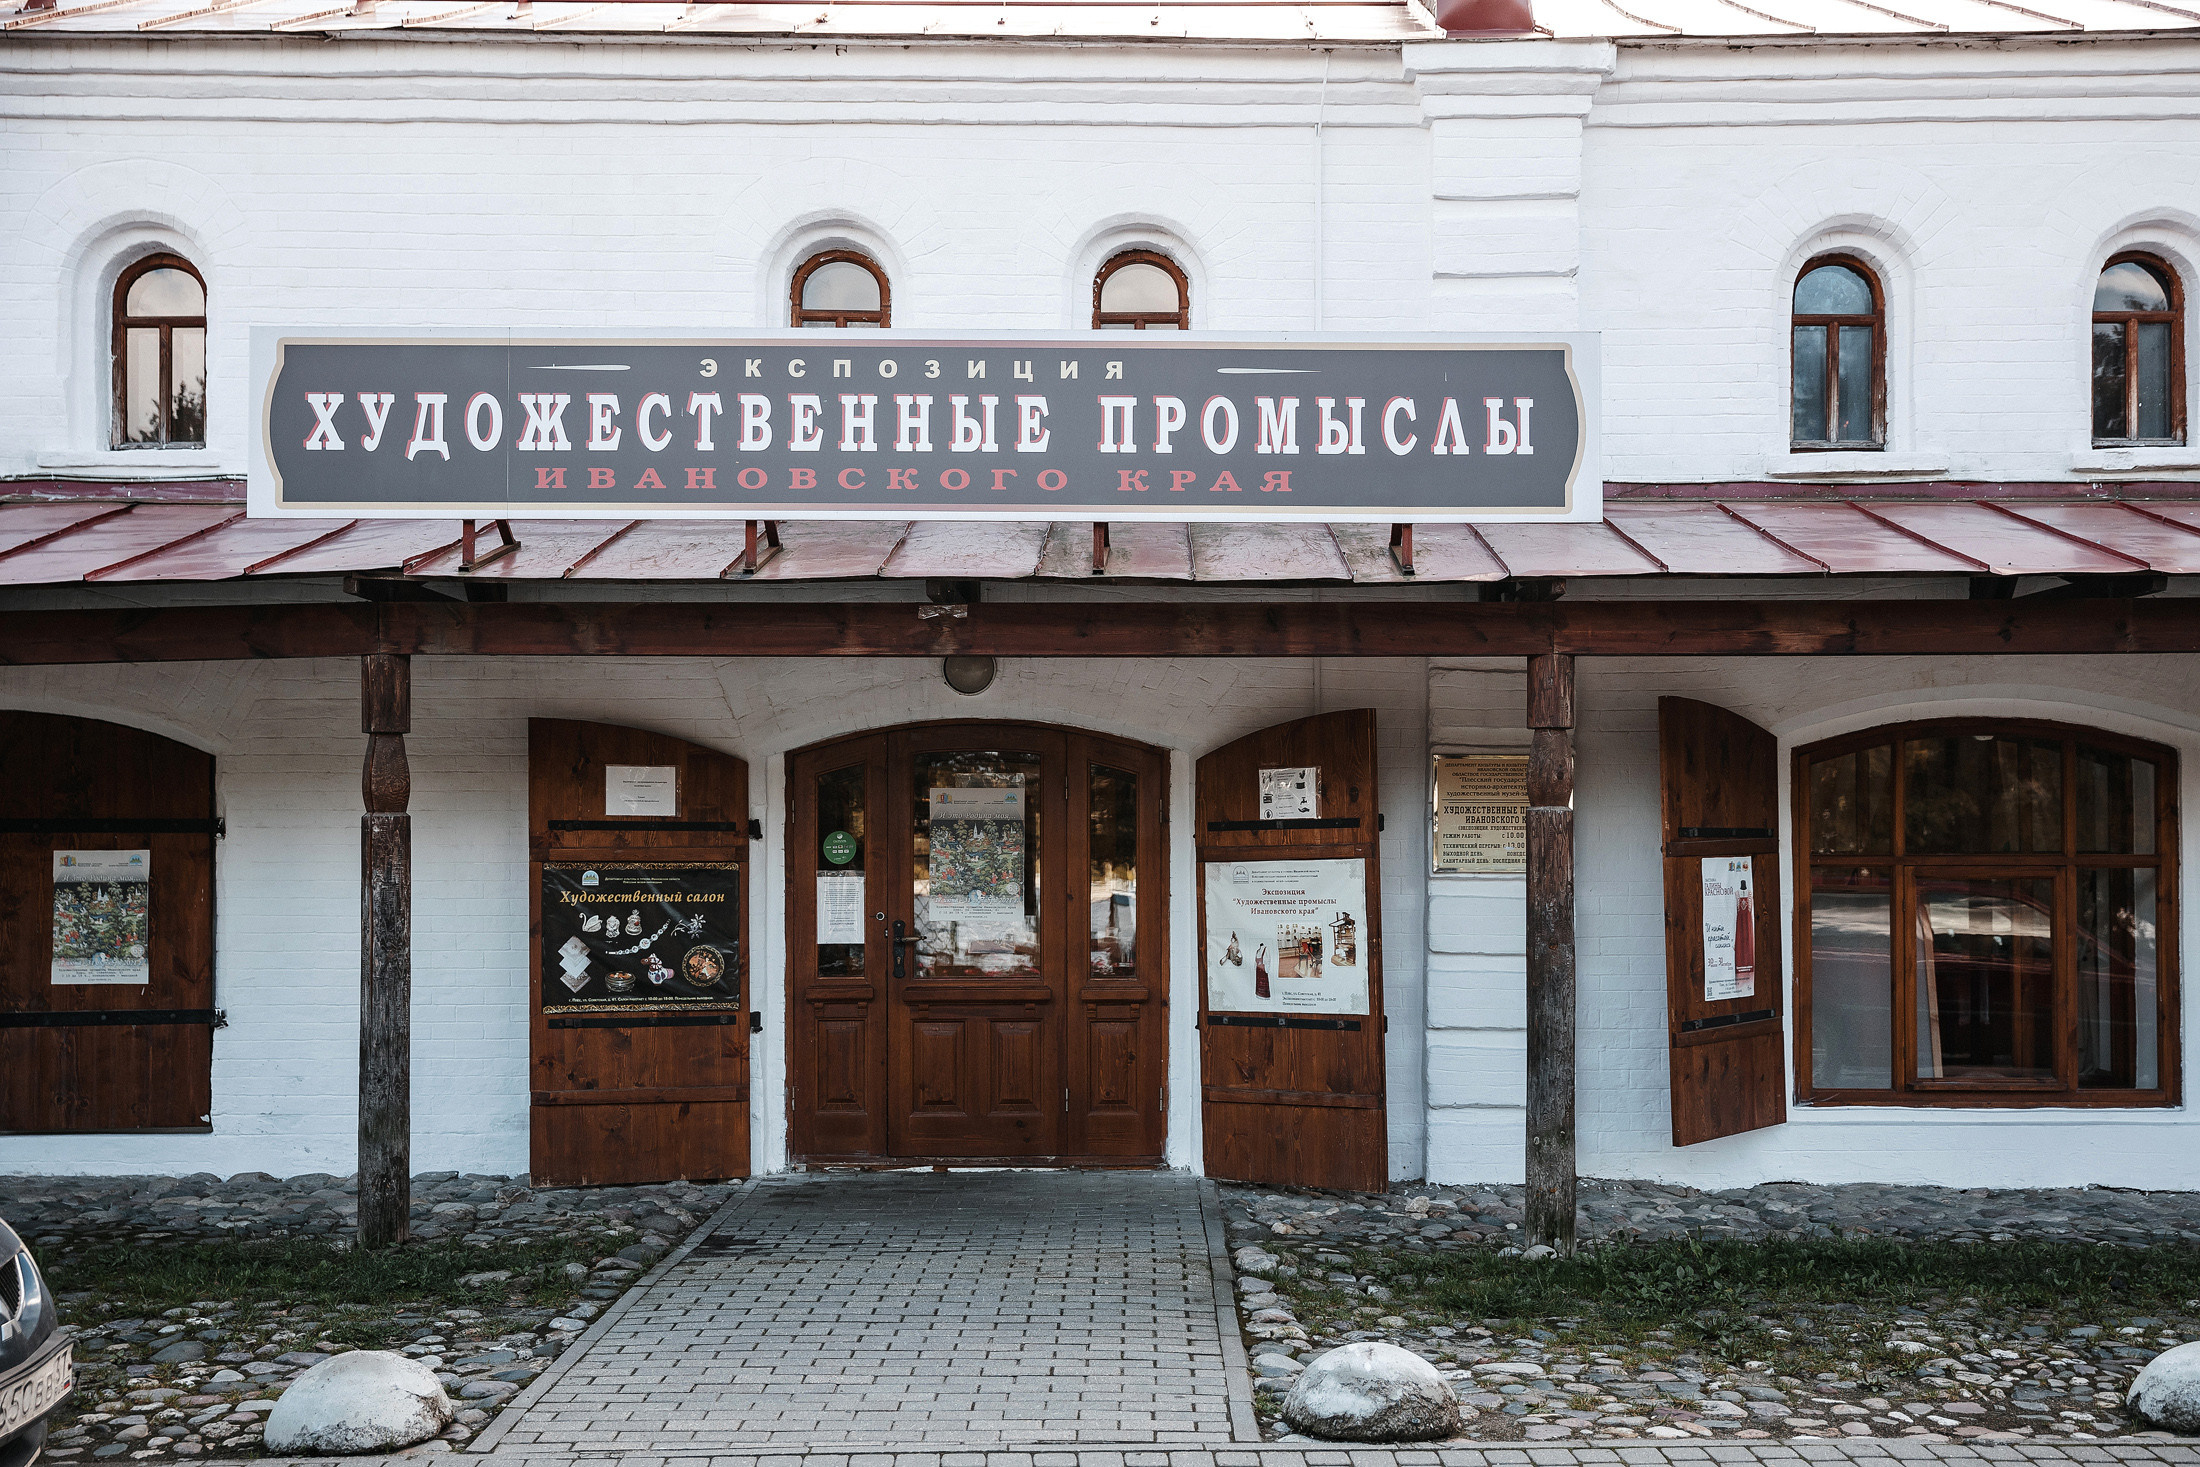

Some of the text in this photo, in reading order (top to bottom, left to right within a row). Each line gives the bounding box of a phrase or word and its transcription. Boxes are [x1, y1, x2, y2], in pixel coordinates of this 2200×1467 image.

[698, 358, 1124, 381] ЭКСПОЗИЦИЯ
[303, 390, 1535, 462] ХУДОЖЕСТВЕННЫЕ ПРОМЫСЛЫ
[534, 466, 1294, 493] ИВАНОВСКОГО КРАЯ
[1446, 790, 1501, 798] художественный
[1443, 806, 1518, 815] ХУДОЖЕСТВЕННЫЕ
[1465, 815, 1520, 824] ИВАНОВСКОГО
[1261, 888, 1306, 896] Экспозиция
[560, 889, 725, 906] Художественный салон
[1298, 898, 1337, 906] промыслы
[1250, 907, 1297, 915] Ивановского
